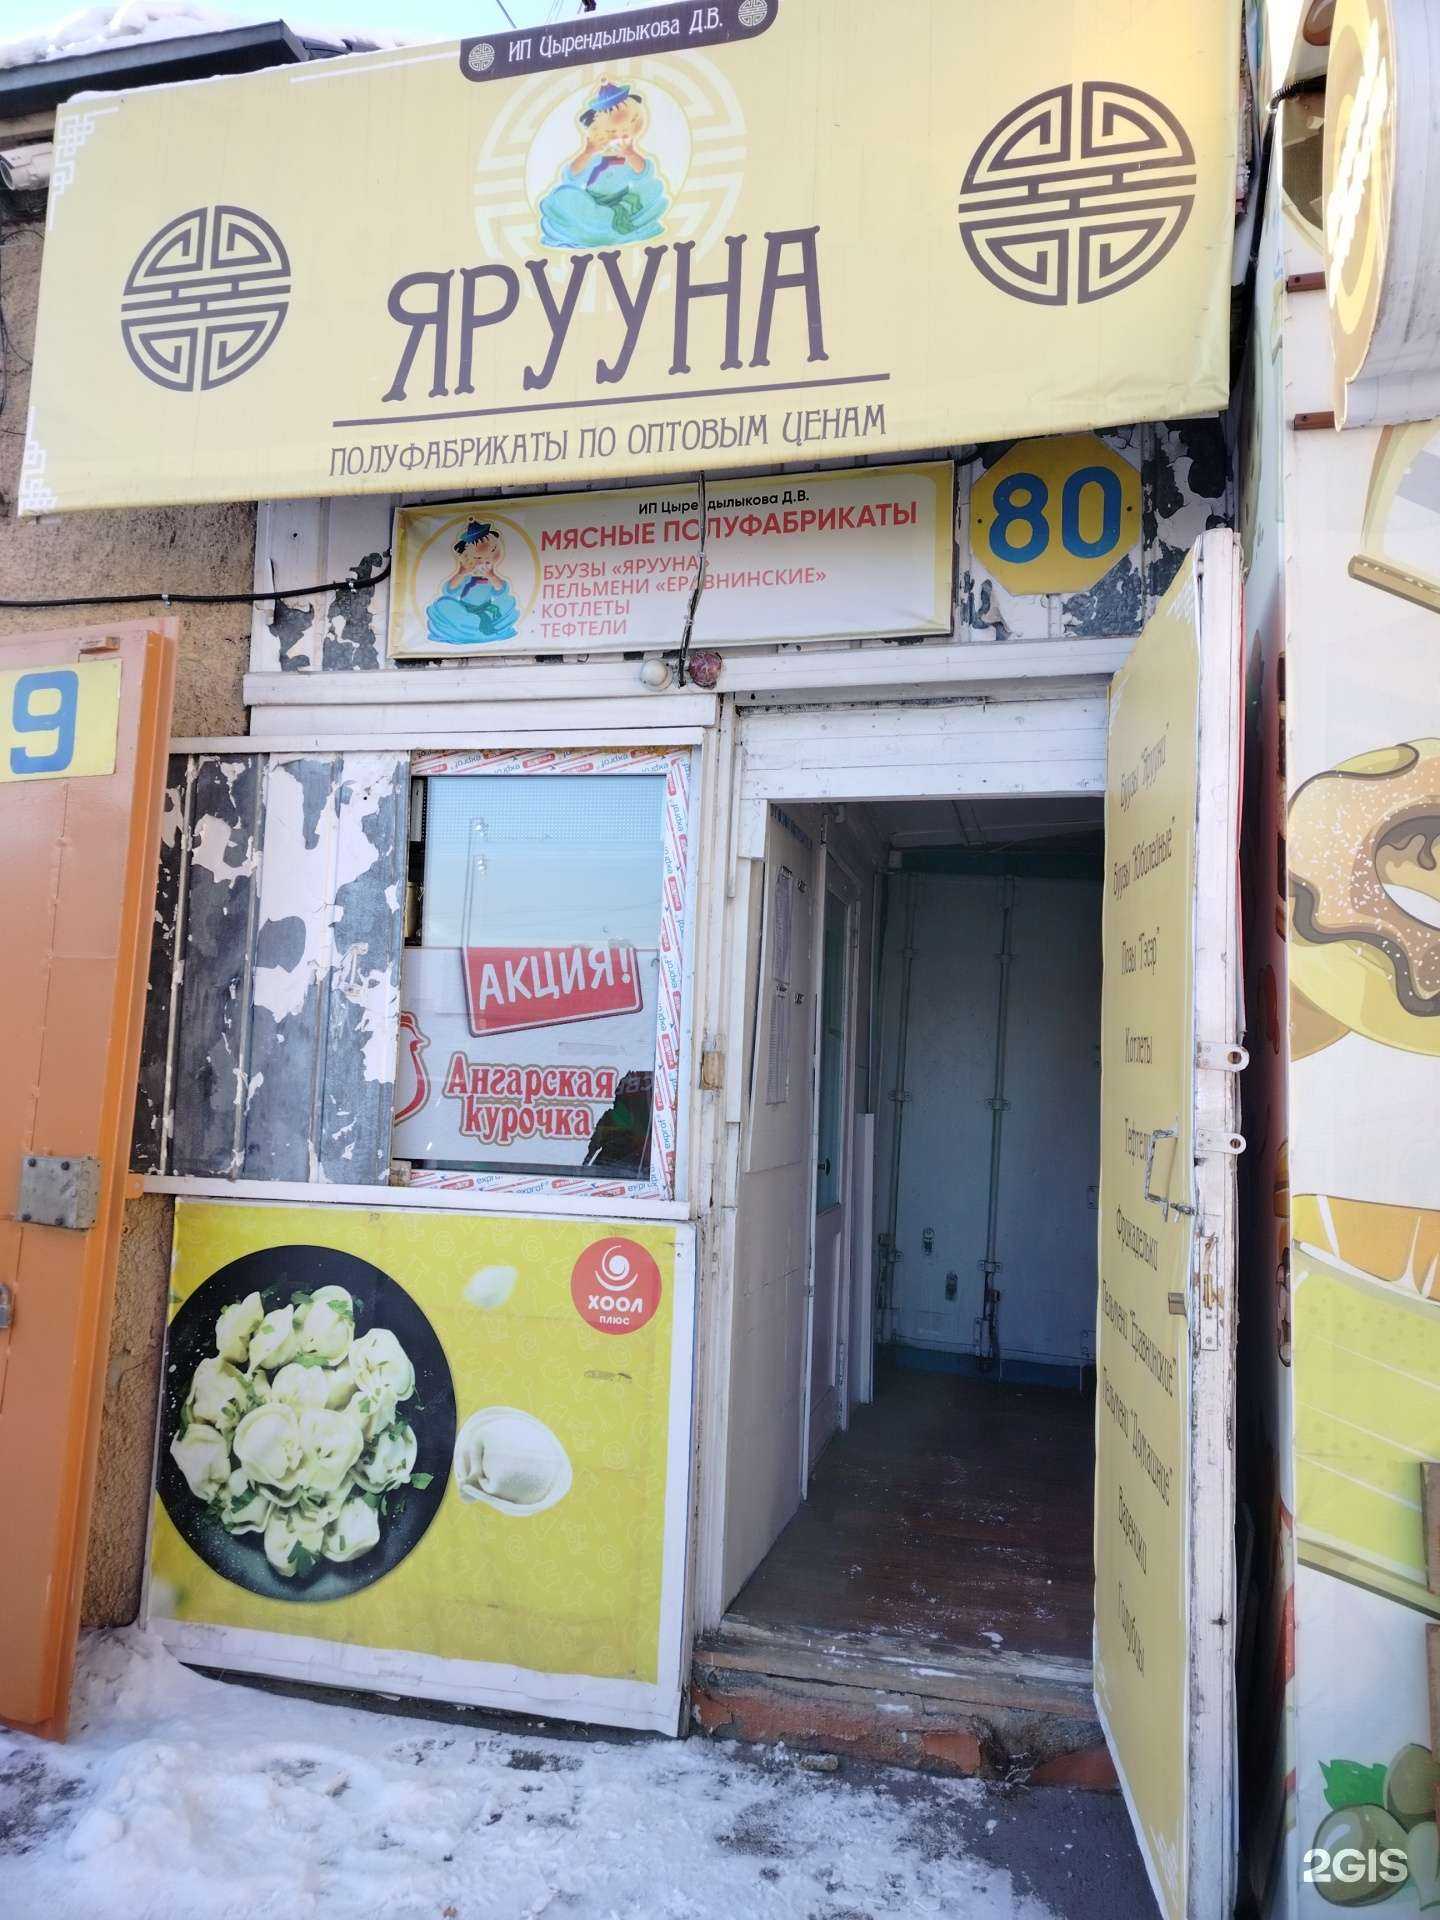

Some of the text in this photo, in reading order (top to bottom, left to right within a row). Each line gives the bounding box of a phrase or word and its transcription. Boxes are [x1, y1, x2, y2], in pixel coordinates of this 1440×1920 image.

[508, 7, 724, 62] ИП Цырендылыкова Д.В.
[381, 225, 829, 403] ЯРУУНА
[329, 403, 887, 477] ПОЛУФАБРИКАТЫ ПО ОПТОВЫМ ЦЕНАМ
[541, 501, 918, 551] МЯСНЫЕ ПОЛУФАБРИКАТЫ
[638, 489, 810, 515] ИП Цыредылыкова Д.В.
[989, 466, 1122, 564] 80
[542, 578, 649, 599] ПЕЛЬМЕНИ
[543, 560, 606, 580] БУУЗЫ
[541, 619, 627, 639] ТЕФТЕЛИ
[542, 600, 630, 619] КОТЛЕТЫ
[10, 670, 79, 774] 9
[479, 945, 634, 1010] АКЦИЯ!
[1125, 1027, 1152, 1065] Котлеты
[447, 1055, 617, 1105] Ангарская
